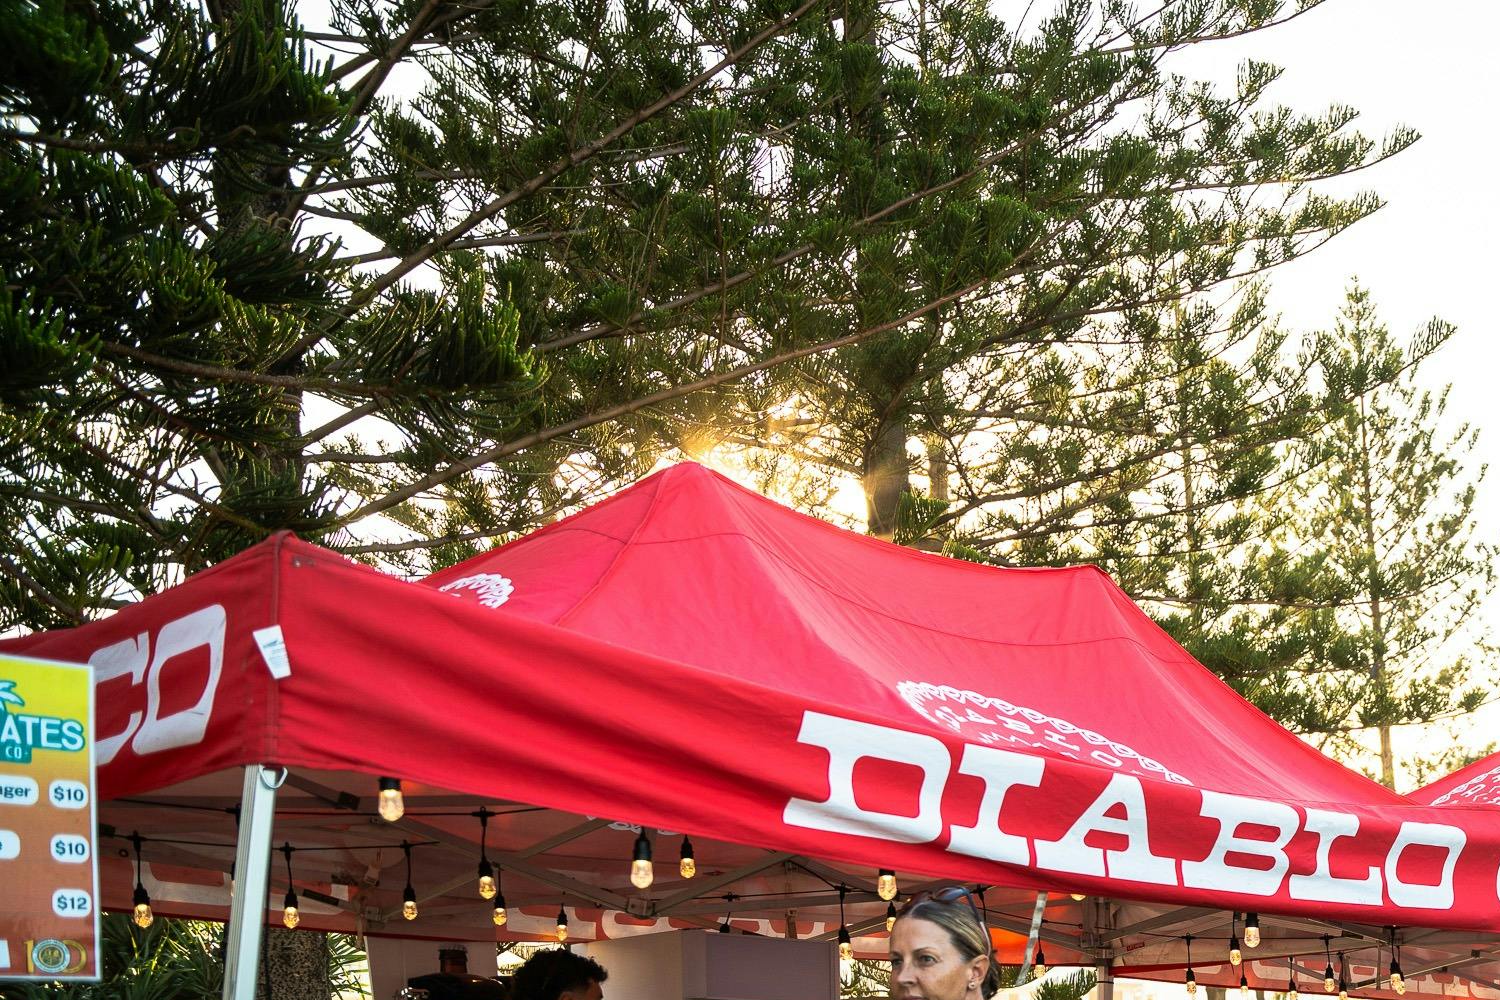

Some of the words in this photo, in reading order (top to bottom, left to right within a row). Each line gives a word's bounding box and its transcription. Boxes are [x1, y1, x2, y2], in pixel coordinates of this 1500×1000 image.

[54, 785, 84, 802] $10
[783, 710, 1467, 910] DIABLO
[55, 841, 86, 856] $10
[57, 896, 87, 911] $12
